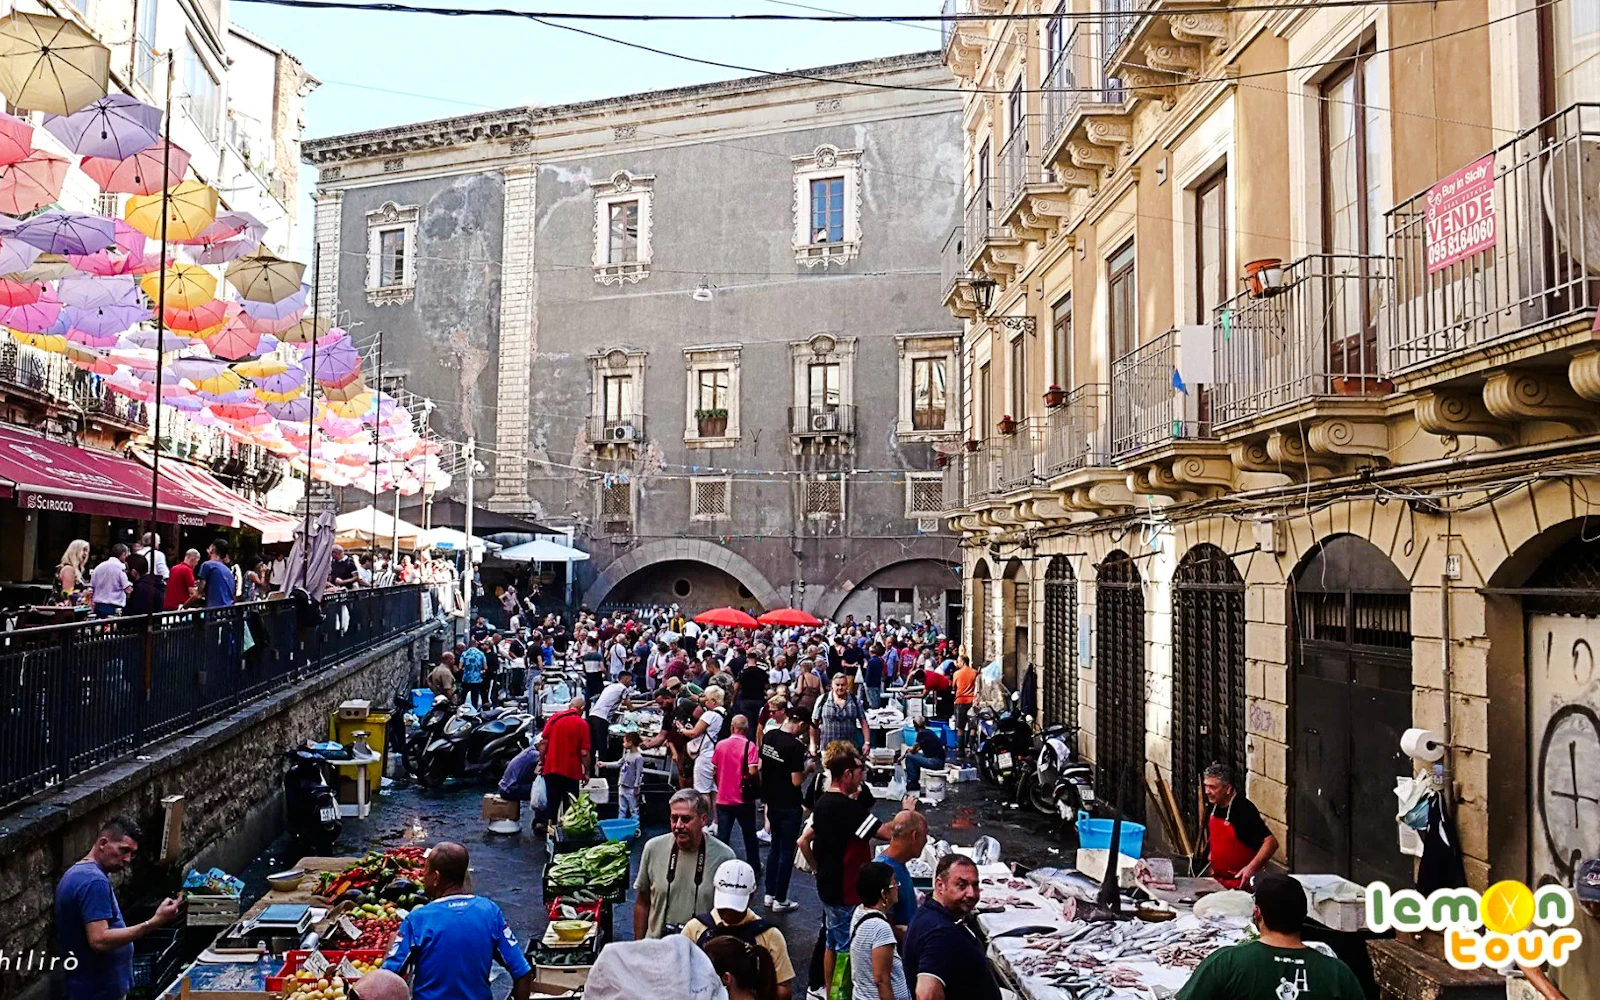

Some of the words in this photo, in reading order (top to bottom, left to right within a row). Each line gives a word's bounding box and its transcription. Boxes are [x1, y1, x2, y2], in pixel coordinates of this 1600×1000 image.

[1441, 182, 1457, 197] Buy
[1456, 177, 1465, 190] in
[1463, 165, 1488, 185] Sicily
[1443, 199, 1460, 211] REAL
[1462, 184, 1487, 202] ESTATE
[1428, 191, 1493, 242] VENDE
[1428, 238, 1447, 265] 095
[1447, 216, 1494, 256] 8164060
[36, 494, 74, 512] SCIROCCO
